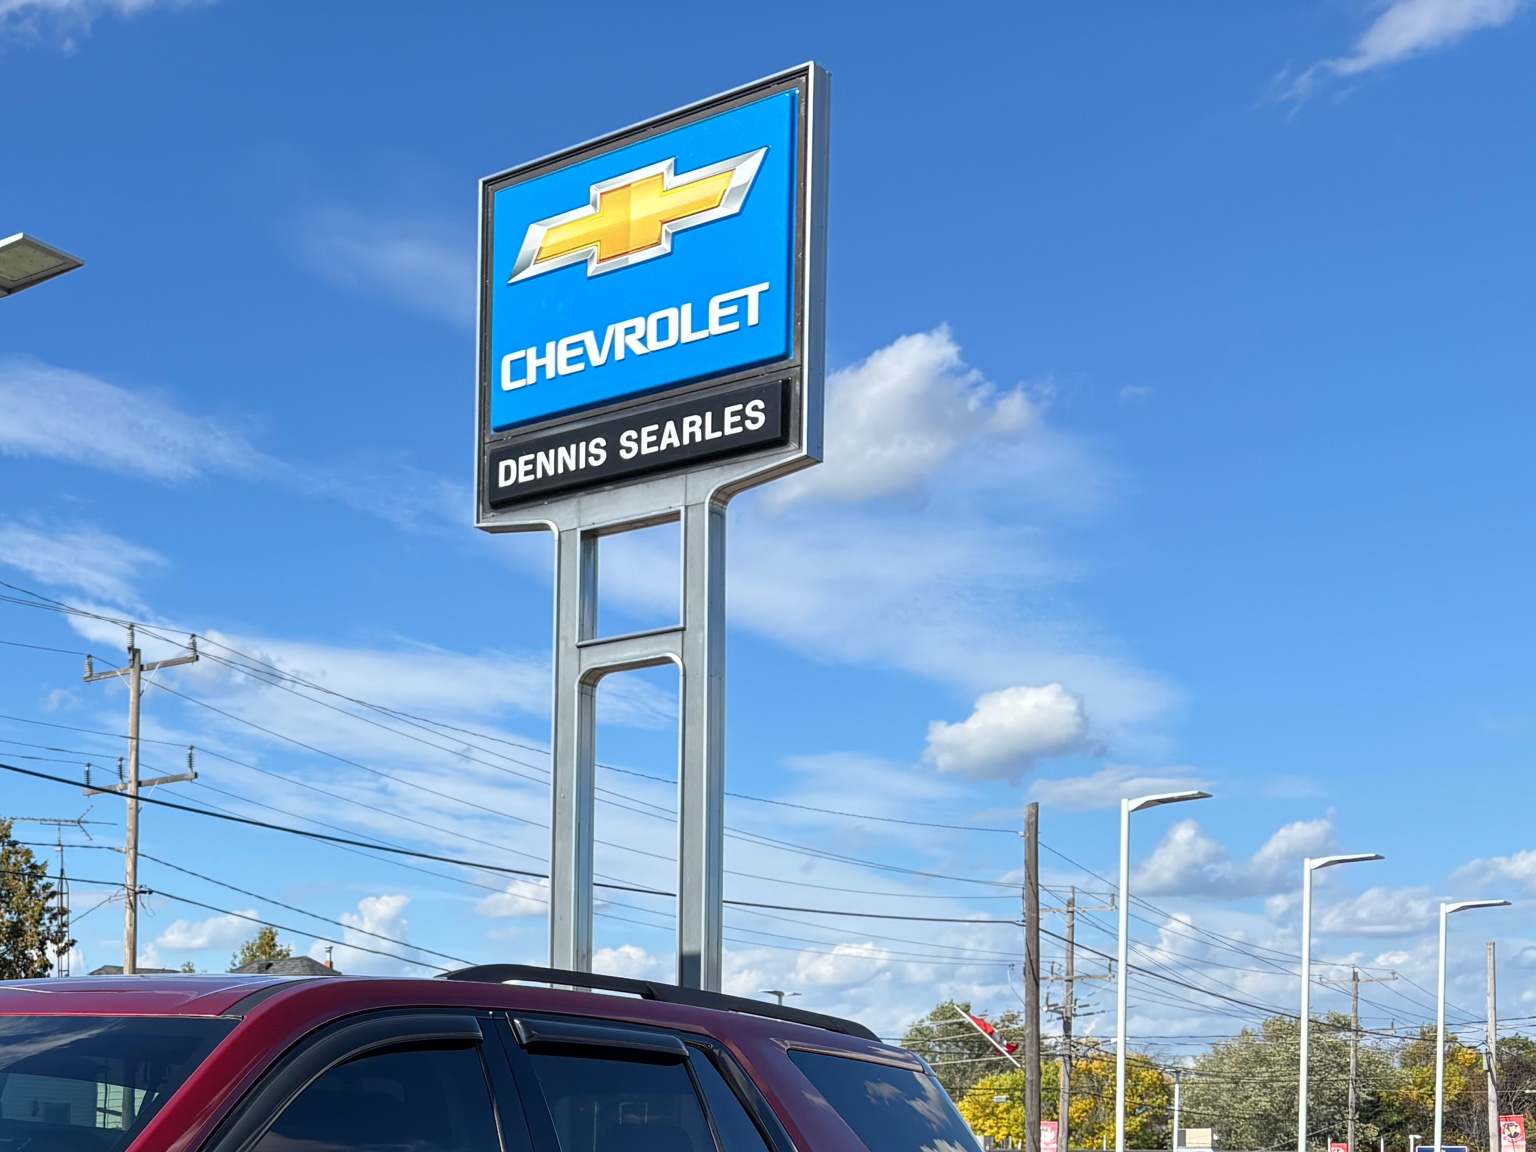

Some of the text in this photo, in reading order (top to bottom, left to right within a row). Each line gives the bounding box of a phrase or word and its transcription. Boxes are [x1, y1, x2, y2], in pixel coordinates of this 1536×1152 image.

[500, 282, 770, 391] CHEVROLET
[498, 399, 765, 488] DENNIS SEARLES
